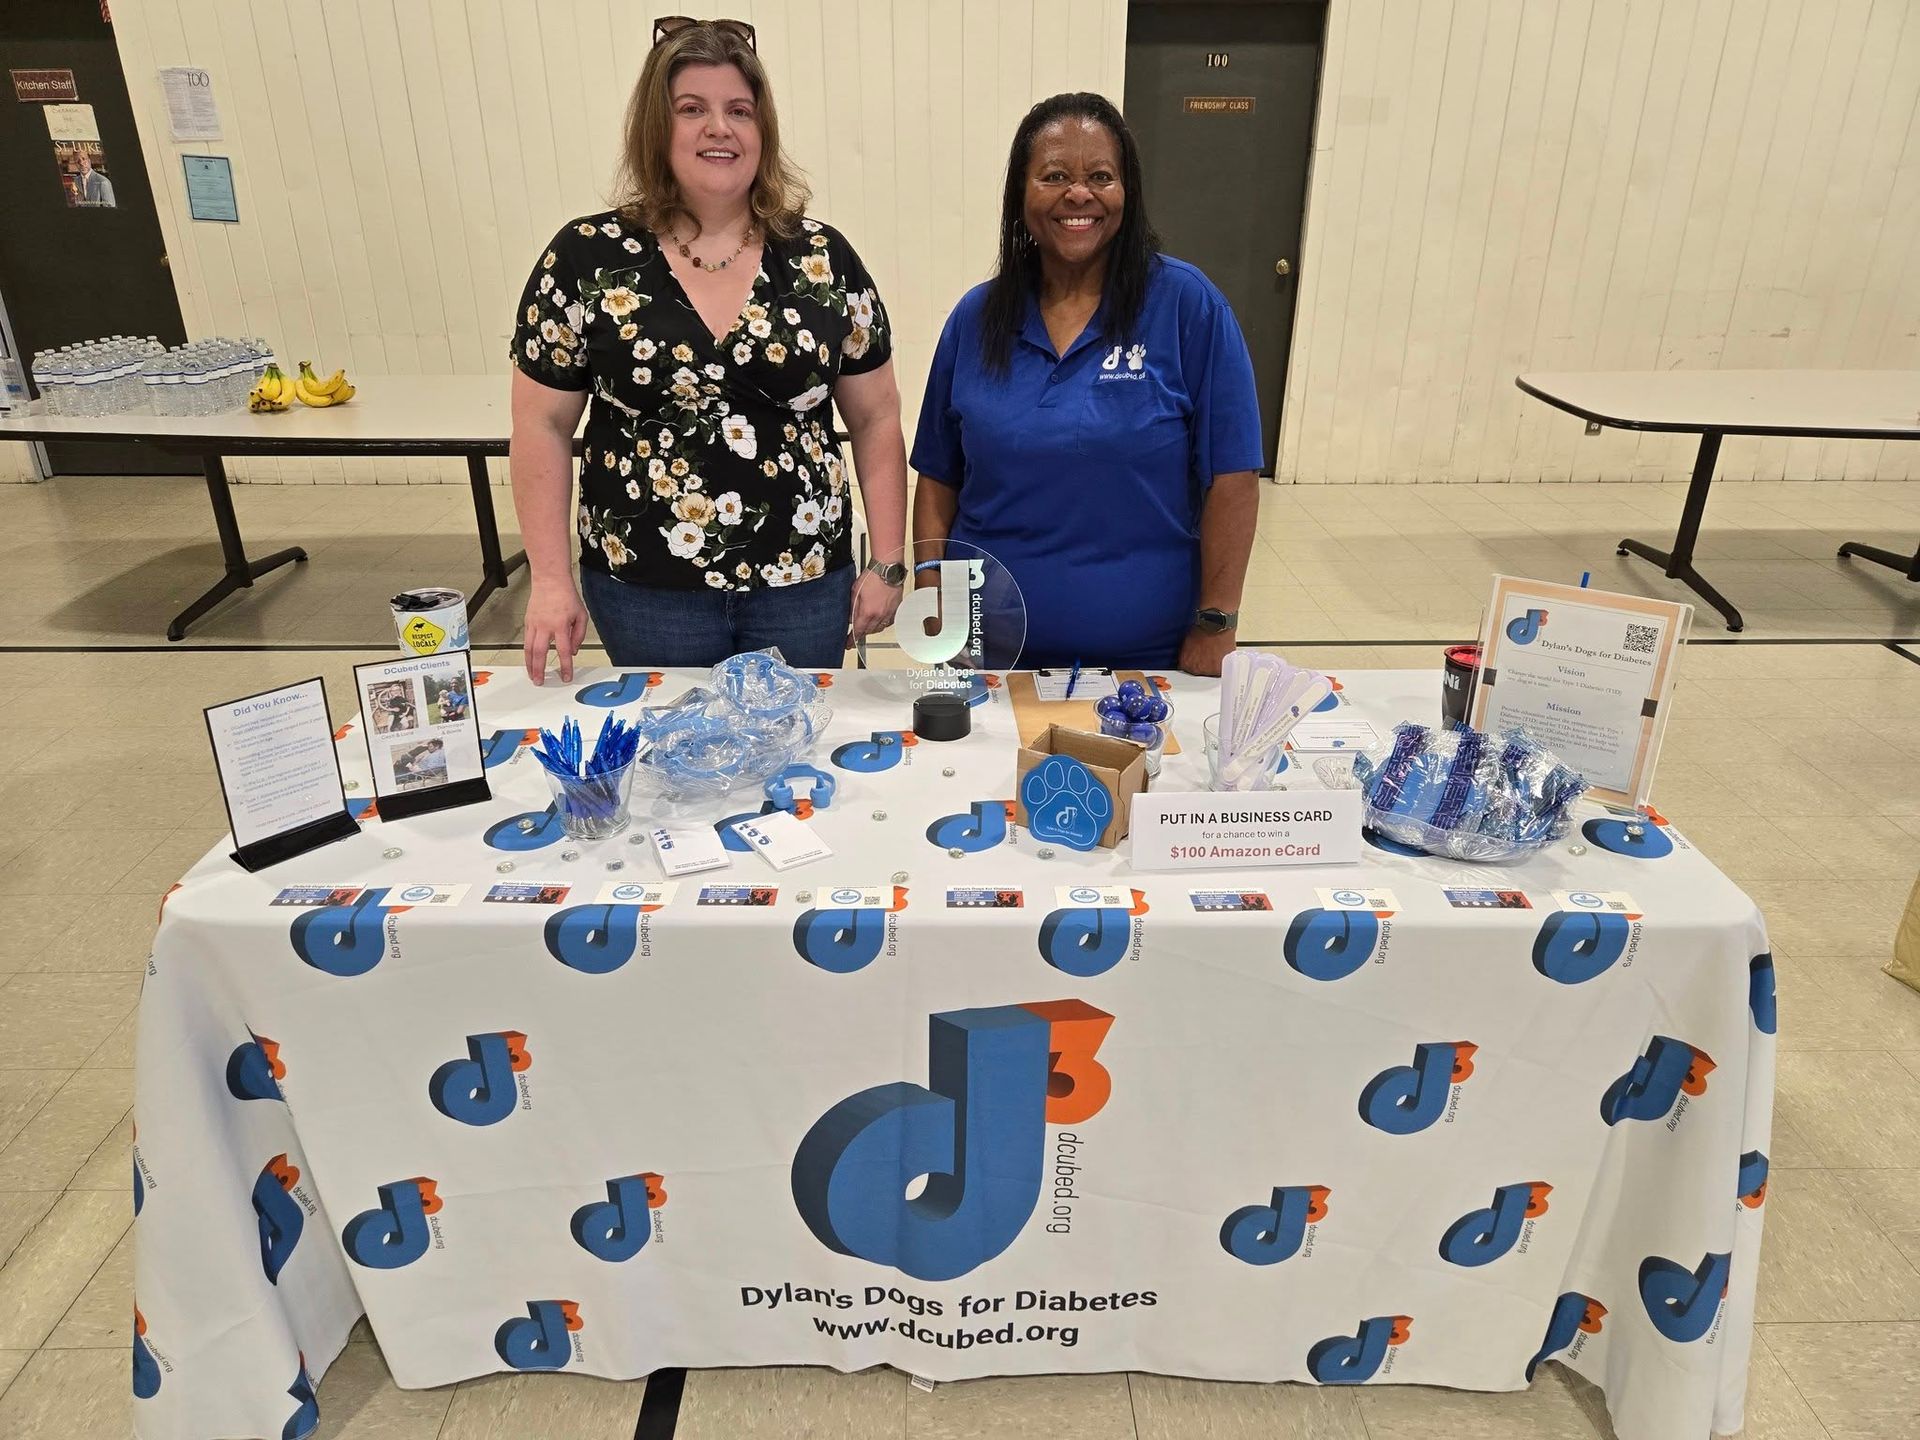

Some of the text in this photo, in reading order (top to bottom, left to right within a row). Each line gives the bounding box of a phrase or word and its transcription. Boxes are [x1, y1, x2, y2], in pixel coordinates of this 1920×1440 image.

[1207, 54, 1228, 67] 100
[16, 80, 73, 90] Kitchen Staff
[187, 72, 210, 87] 100
[1190, 101, 1249, 110] FRIENDSHIP CLASS
[72, 141, 102, 153] LUKE
[970, 593, 984, 657] dcubed.org
[412, 640, 437, 648] LOCALS
[1541, 640, 1652, 666] Dylan's Dogs for Diabetes
[384, 660, 451, 675] DCubed Clients
[906, 667, 975, 679] Dylan's Dogs
[1556, 666, 1586, 678] Vision
[909, 680, 973, 690] for Diabetes
[233, 692, 308, 718] Did You Know...
[1546, 702, 1582, 716] Mission
[1160, 810, 1333, 825] PUT IN A BUSINESS CARD
[1202, 831, 1216, 840] for
[1223, 830, 1256, 839] chance
[1257, 830, 1266, 838] to
[1267, 830, 1283, 838] win
[1170, 844, 1322, 860] $100 Amazon eCard
[388, 914, 402, 959] dcubed.org
[640, 914, 652, 957] dcubed.org
[887, 913, 900, 957] dcubed.org
[1130, 917, 1145, 962] dcubed.org
[1375, 920, 1392, 966] dcubed.org
[1623, 922, 1642, 968] dcubed.org
[518, 1073, 532, 1112] dcubed.org
[1445, 1085, 1462, 1123] dcubed.org
[1666, 1094, 1690, 1132] dcubed.org
[133, 1145, 158, 1190] dcubed.org
[1046, 1132, 1085, 1234] dcubed.org
[430, 1215, 445, 1250] dcubed.org
[652, 1209, 665, 1244] dcubed.org
[1303, 1224, 1318, 1258] dcubed.org
[1518, 1220, 1537, 1254] dcubed.org
[740, 1283, 1158, 1318] Dylan's Dogs for Diabetes
[572, 1332, 585, 1363] dcubed.org
[812, 1316, 1080, 1350] www.dcubed.org
[1568, 1331, 1589, 1360] dcubed.org
[142, 1337, 175, 1374] dcubed.org
[1382, 1347, 1400, 1374] dcubed.org
